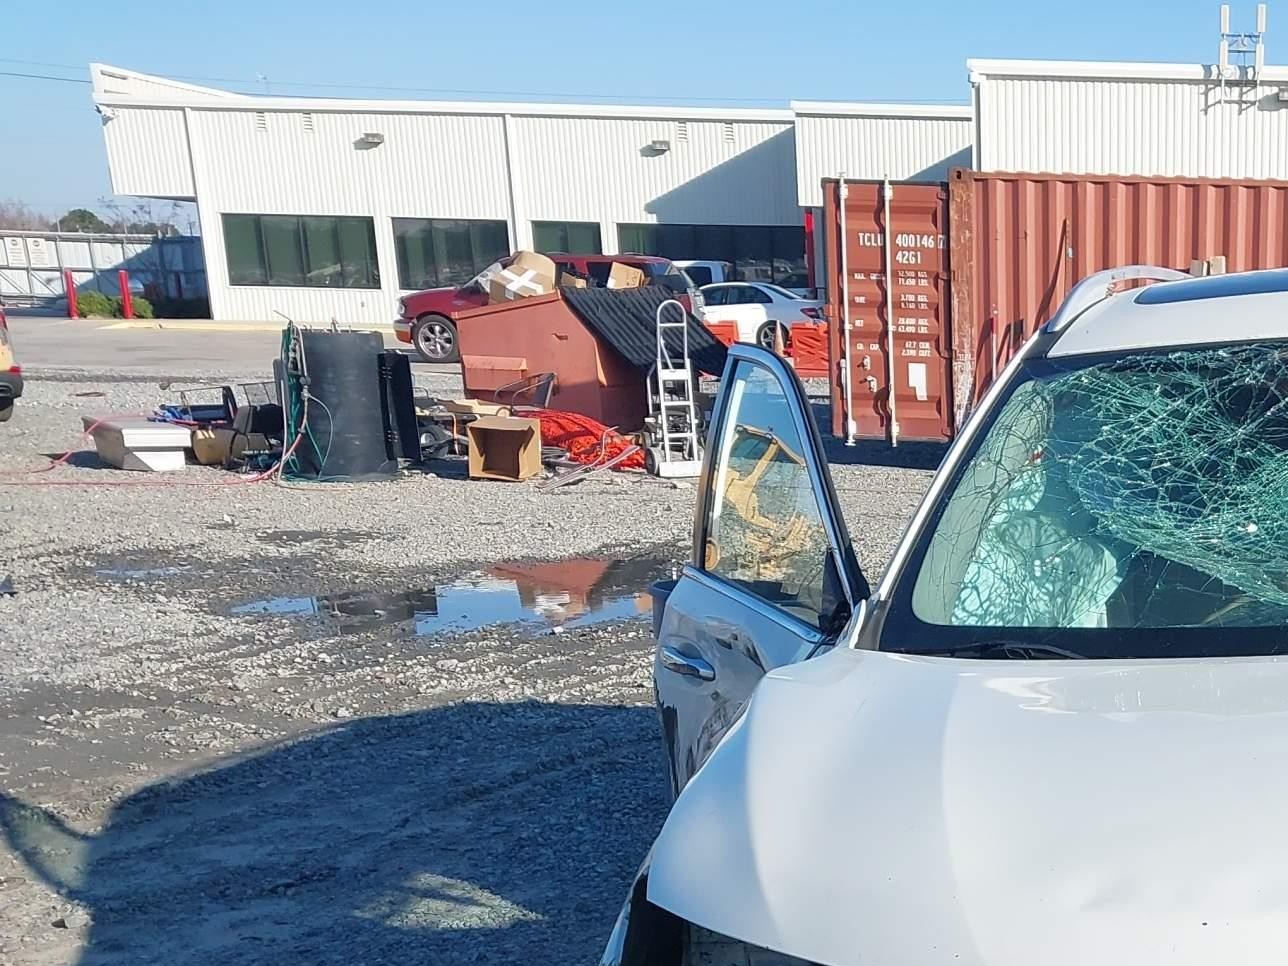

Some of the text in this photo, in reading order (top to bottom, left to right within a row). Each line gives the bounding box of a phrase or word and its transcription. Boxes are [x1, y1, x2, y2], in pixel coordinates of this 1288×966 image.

[858, 232, 884, 246] TCLU
[896, 234, 935, 249] 400146
[896, 251, 921, 264] 42G1
